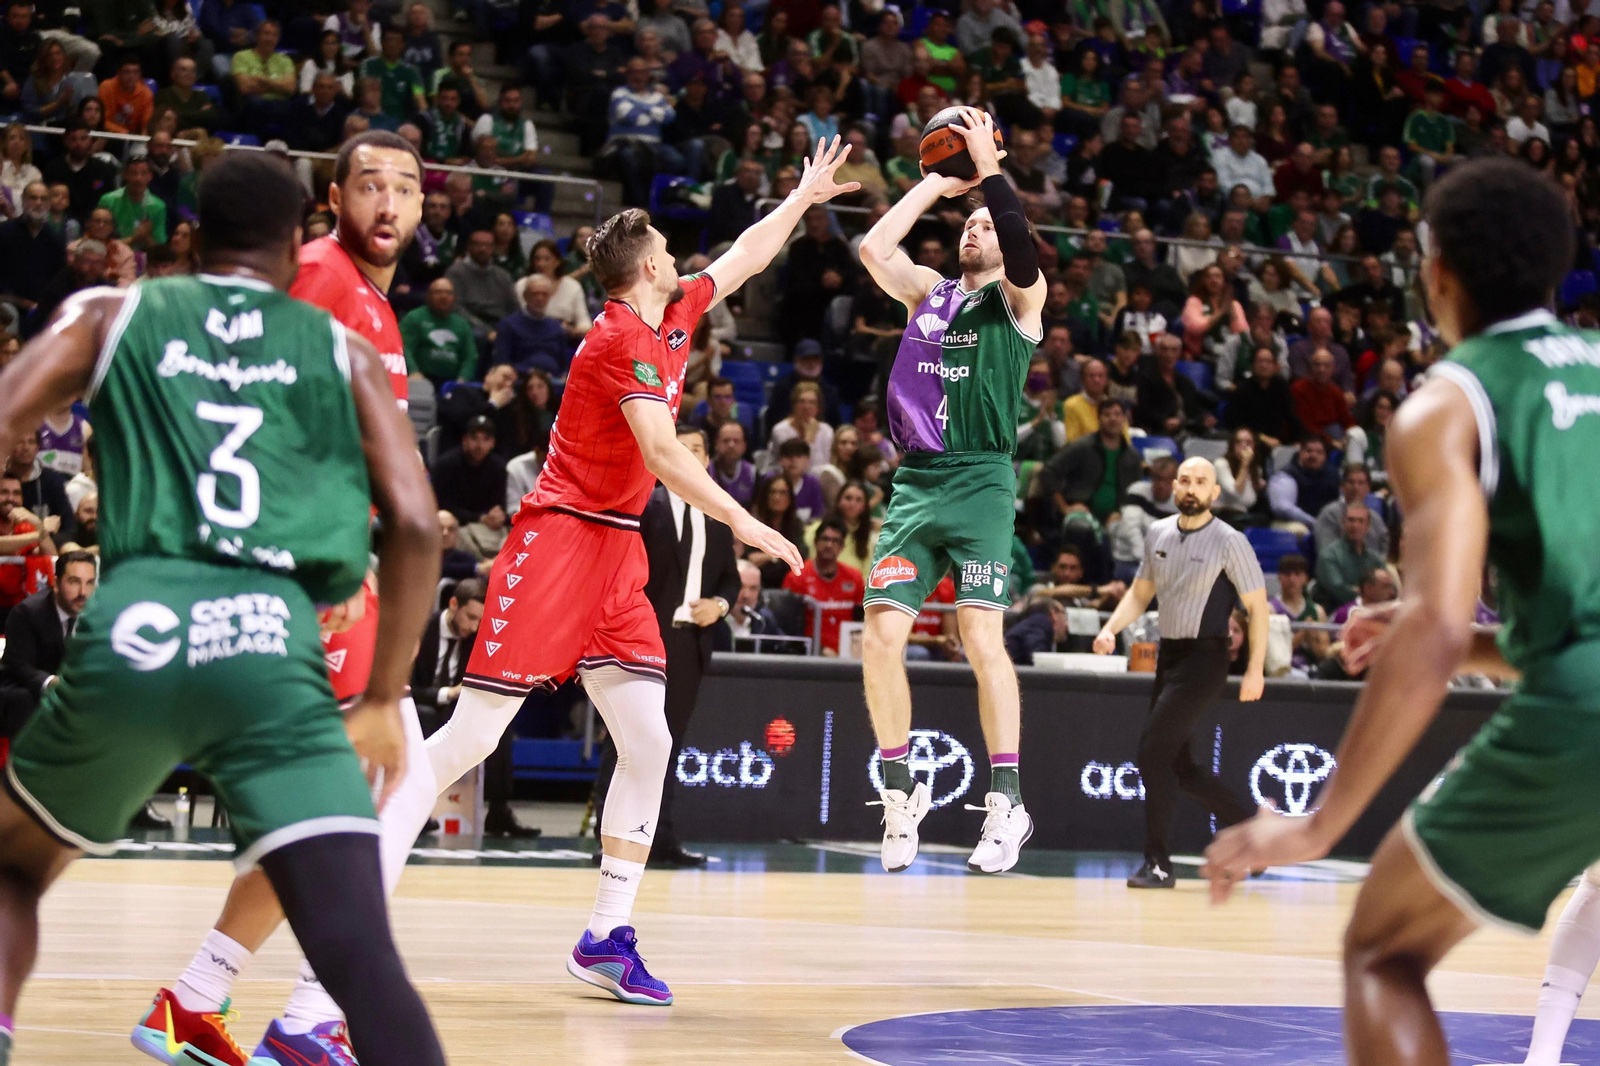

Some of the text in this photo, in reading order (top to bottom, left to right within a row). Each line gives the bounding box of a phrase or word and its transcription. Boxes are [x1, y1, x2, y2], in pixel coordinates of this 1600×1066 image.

[935, 394, 949, 430] 4
[196, 400, 263, 529] 3
[191, 593, 291, 624] COSTA
[188, 613, 290, 646] DEL SOL
[502, 670, 522, 680] vive
[675, 740, 775, 788] acb
[1080, 760, 1146, 800] ac
[601, 869, 628, 883] vive
[211, 953, 239, 976] vive
